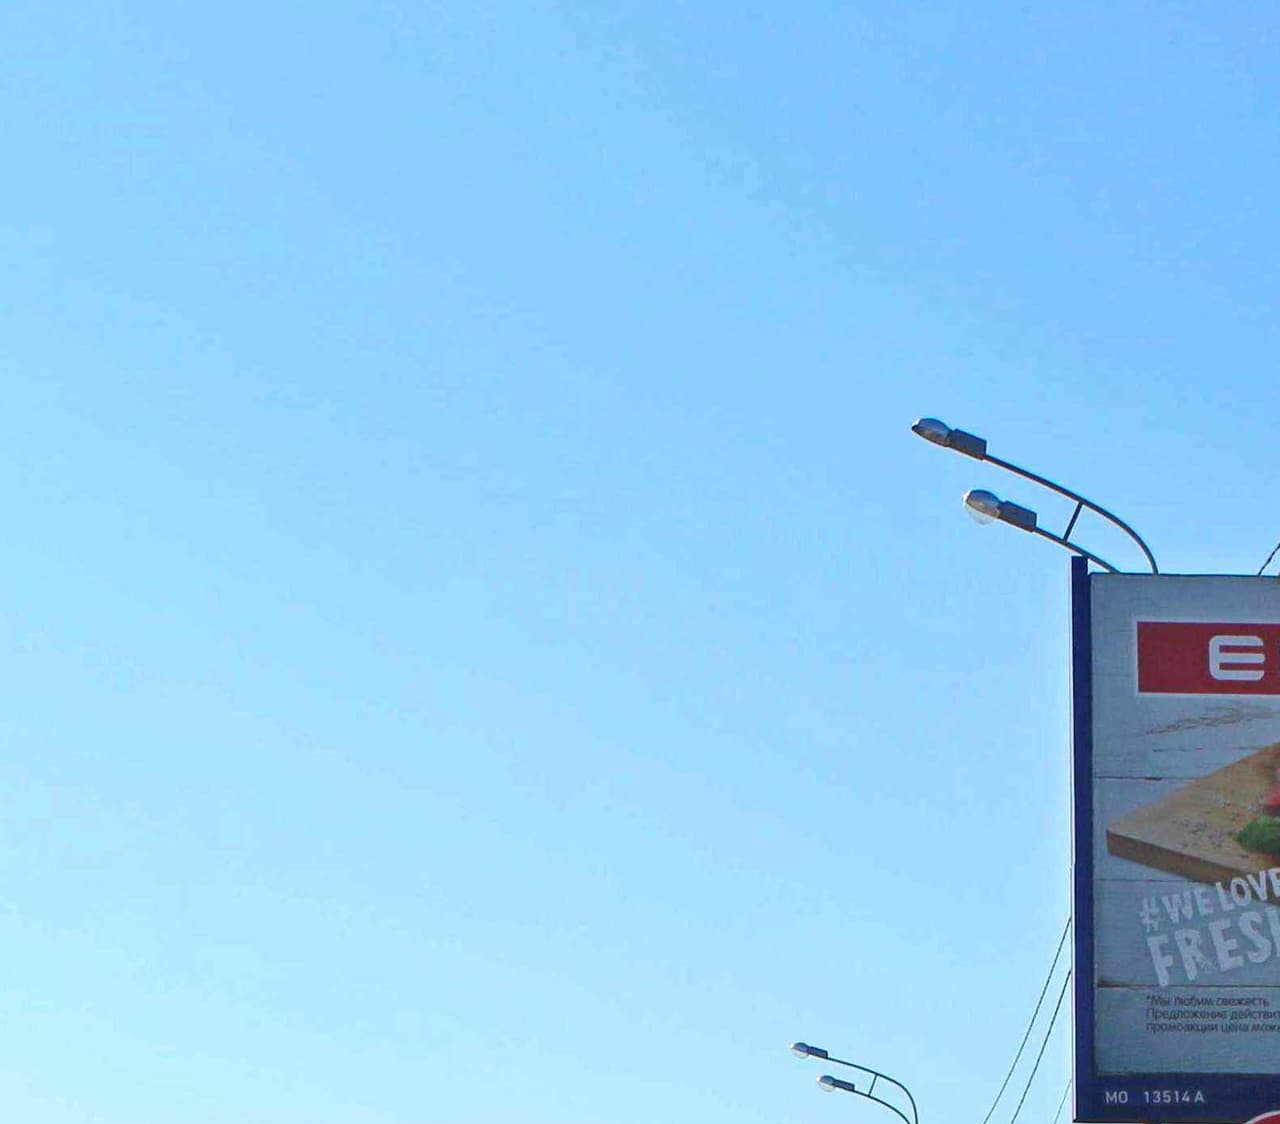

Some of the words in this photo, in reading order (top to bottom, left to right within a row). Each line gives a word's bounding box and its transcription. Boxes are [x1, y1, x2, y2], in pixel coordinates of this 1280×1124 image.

[1174, 995, 1215, 1008] любим
[1216, 996, 1270, 1009] свежесть
[1146, 1007, 1228, 1021] Предложение
[1146, 1021, 1218, 1034] промоакции
[1221, 1022, 1249, 1035] цена
[1143, 1090, 1191, 1104] 13514
